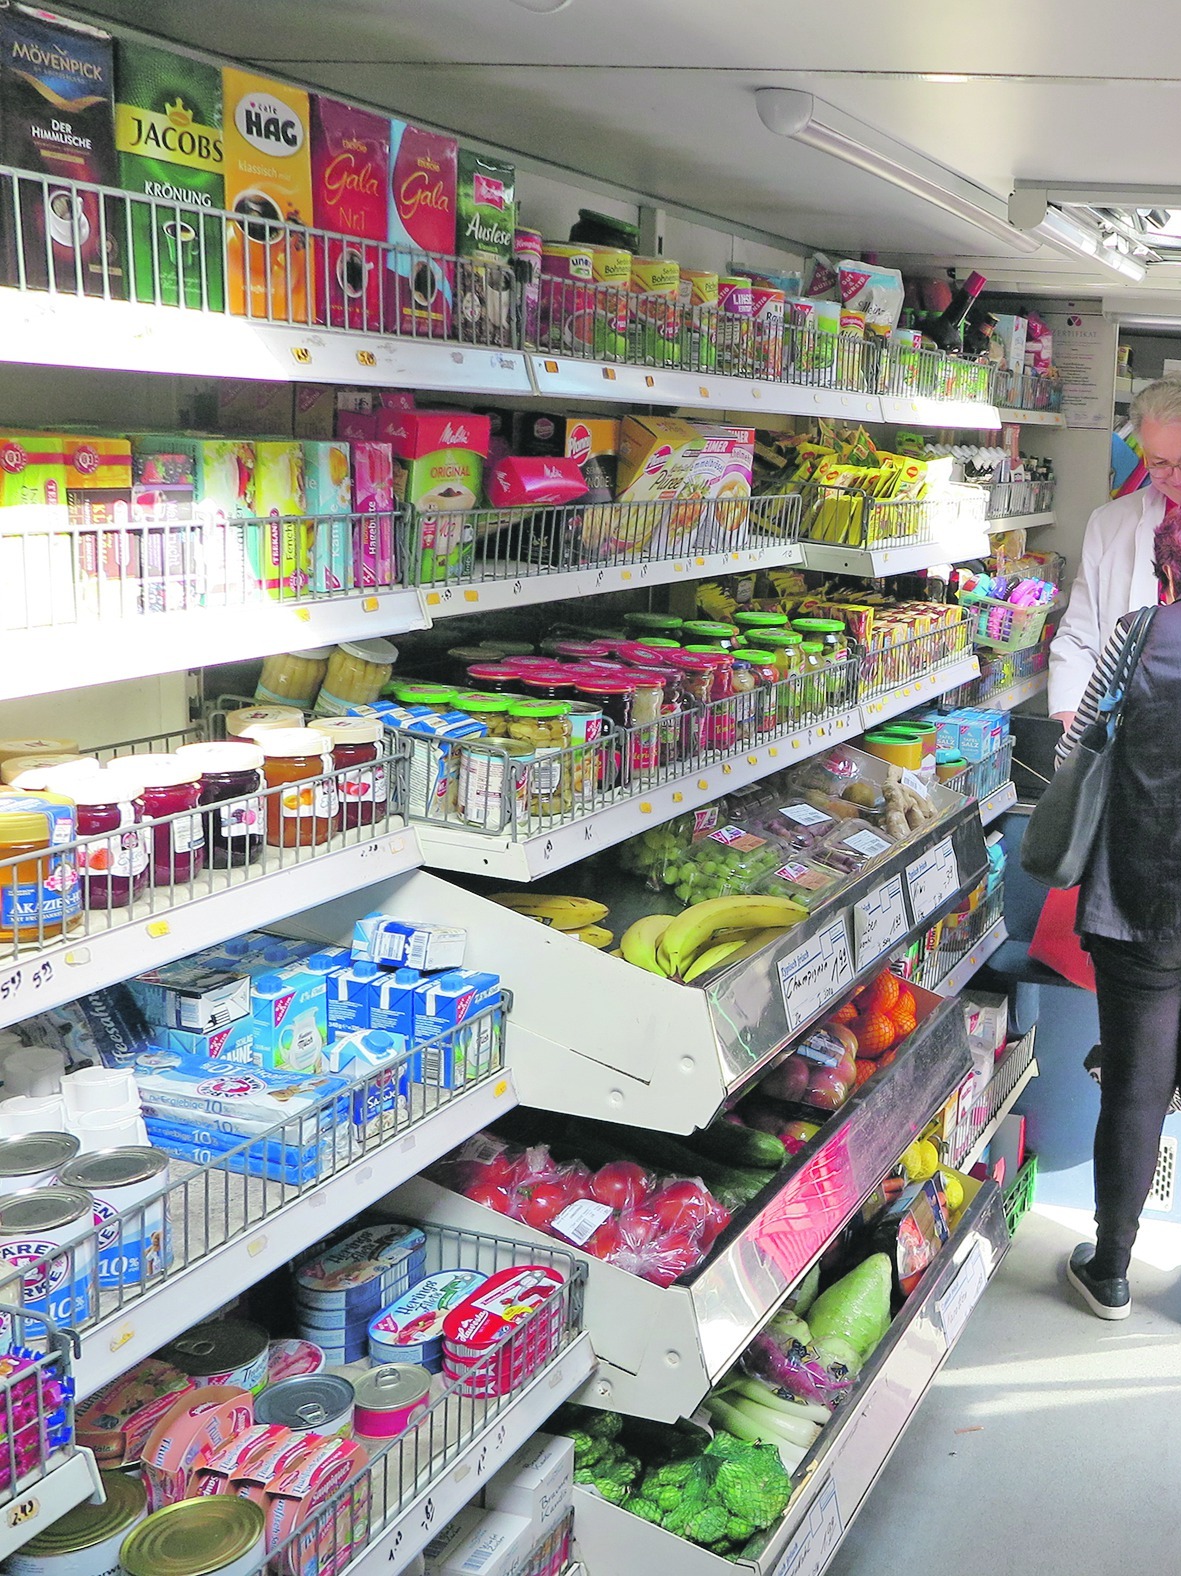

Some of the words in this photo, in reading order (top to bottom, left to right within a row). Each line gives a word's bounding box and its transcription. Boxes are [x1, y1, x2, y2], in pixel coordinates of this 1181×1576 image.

[12, 41, 103, 81] MÖVENPICK
[31, 125, 92, 150] HIMMLISCHE
[51, 119, 72, 134] DER
[130, 117, 223, 163] JACOBS
[245, 109, 297, 148] HAG
[145, 180, 212, 207] KRÖNUNG
[325, 153, 379, 205] Gala
[400, 171, 449, 219] Gala
[466, 213, 511, 246] Auslese
[431, 466, 470, 479] ORIGINAL
[649, 470, 684, 491] Püree
[937, 739, 955, 749] SALZ
[961, 740, 980, 750] SALZ
[781, 958, 797, 978] Typisch
[796, 950, 810, 967] frisch
[394, 1280, 438, 1316] Herings
[455, 1309, 490, 1343] Hawesta
